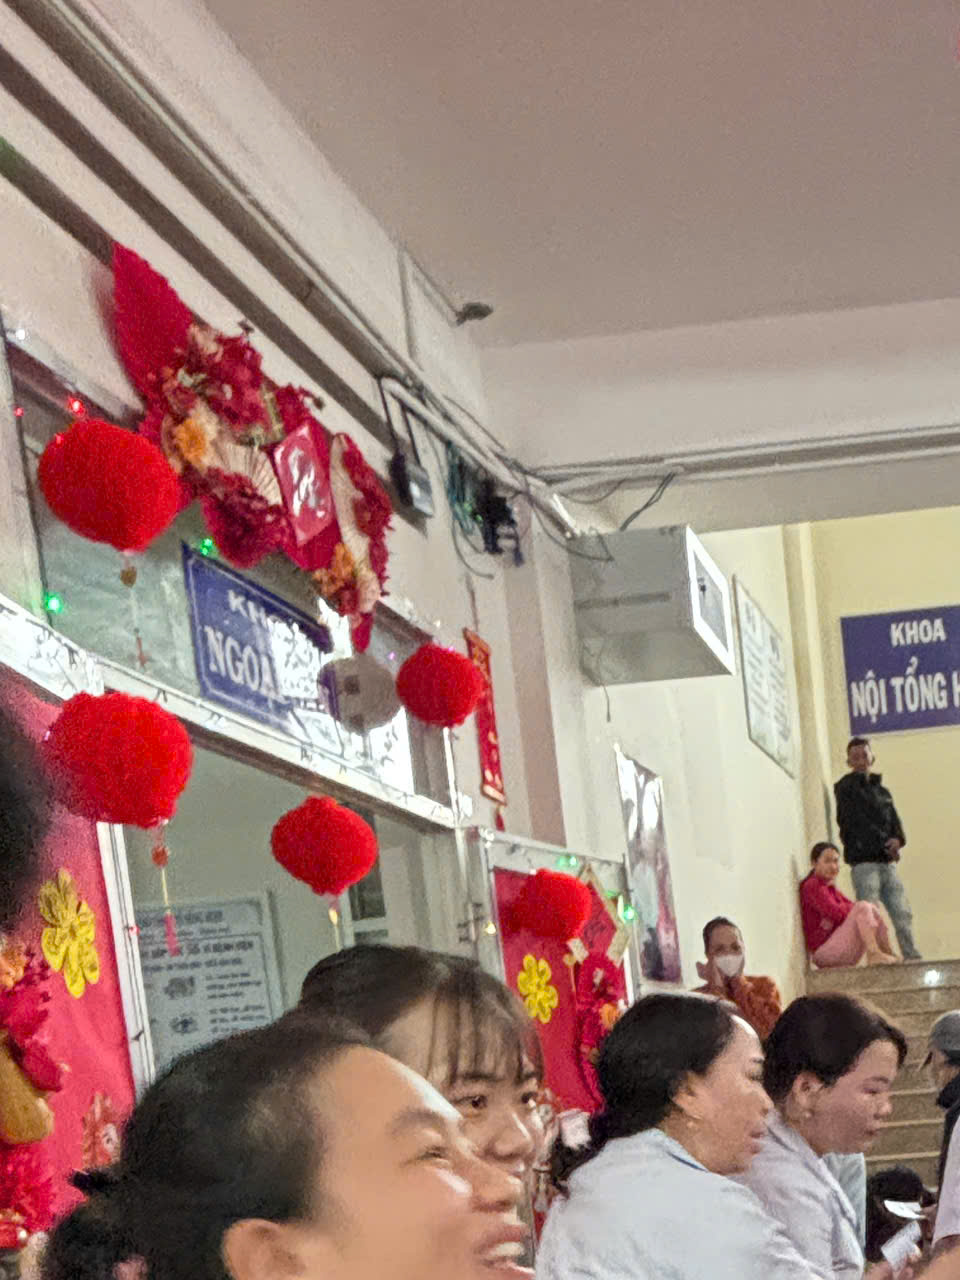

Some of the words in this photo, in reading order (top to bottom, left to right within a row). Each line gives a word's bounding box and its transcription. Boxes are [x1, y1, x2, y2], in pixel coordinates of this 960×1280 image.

[890, 617, 946, 647] KHOA
[850, 669, 888, 723] NỘI
[889, 655, 948, 713] TỔNG
